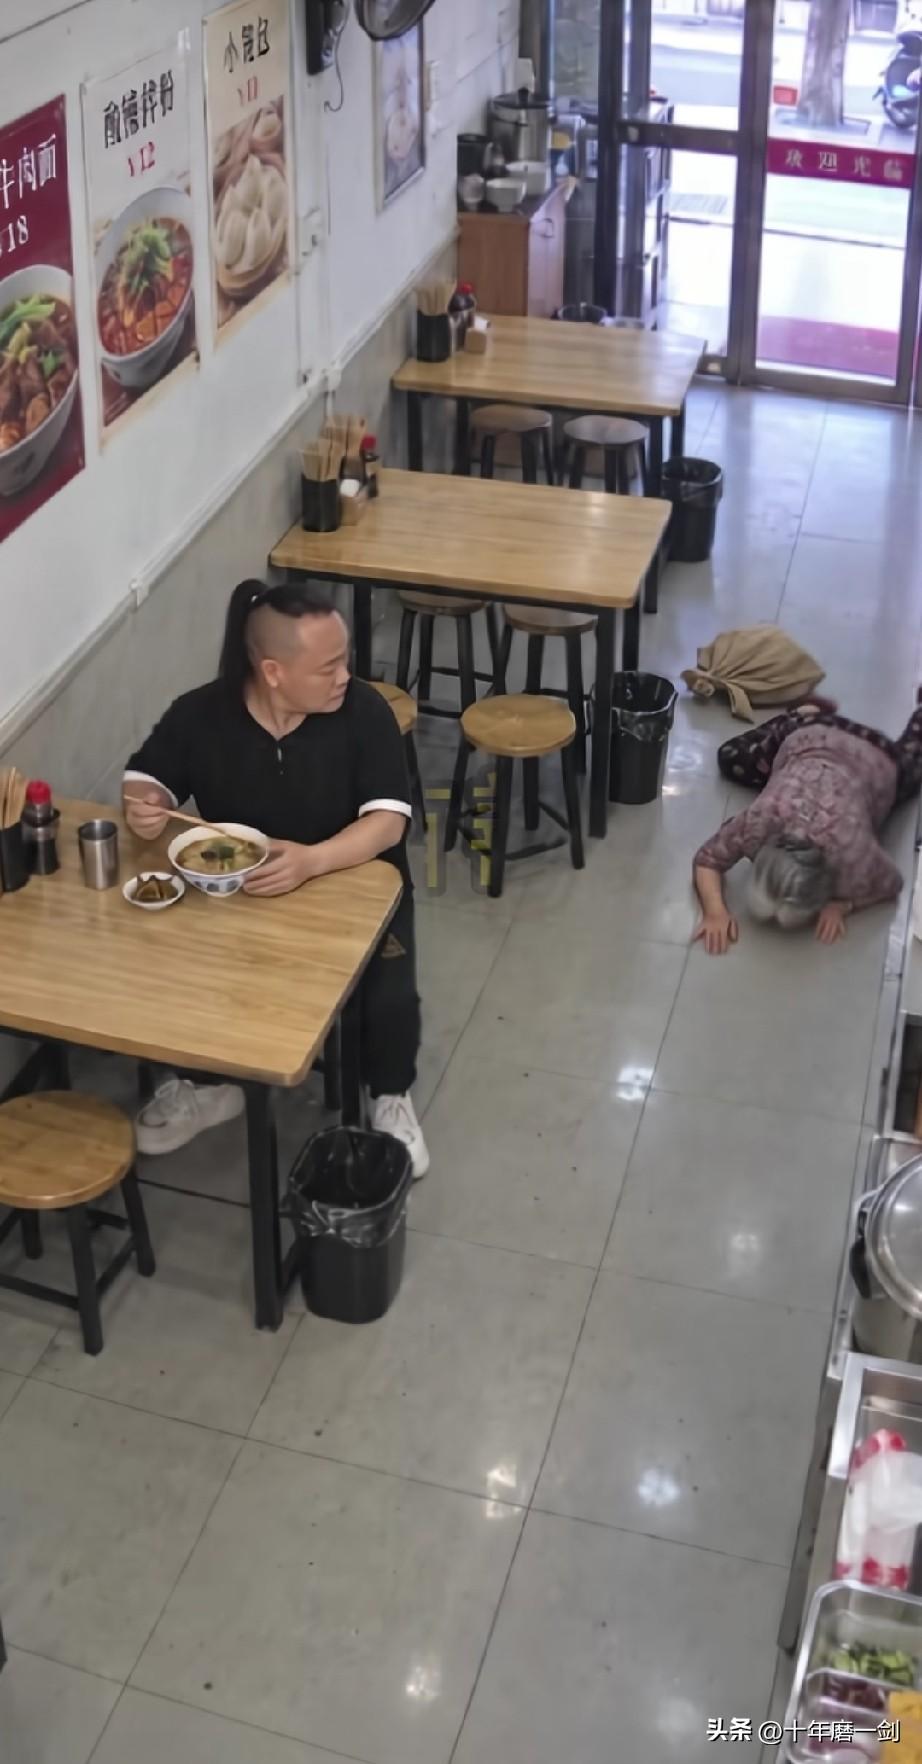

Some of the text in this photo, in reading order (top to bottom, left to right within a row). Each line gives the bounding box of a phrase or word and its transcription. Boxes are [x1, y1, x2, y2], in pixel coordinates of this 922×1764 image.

[0, 132, 57, 209] 牛肉面
[0, 209, 30, 257] 18
